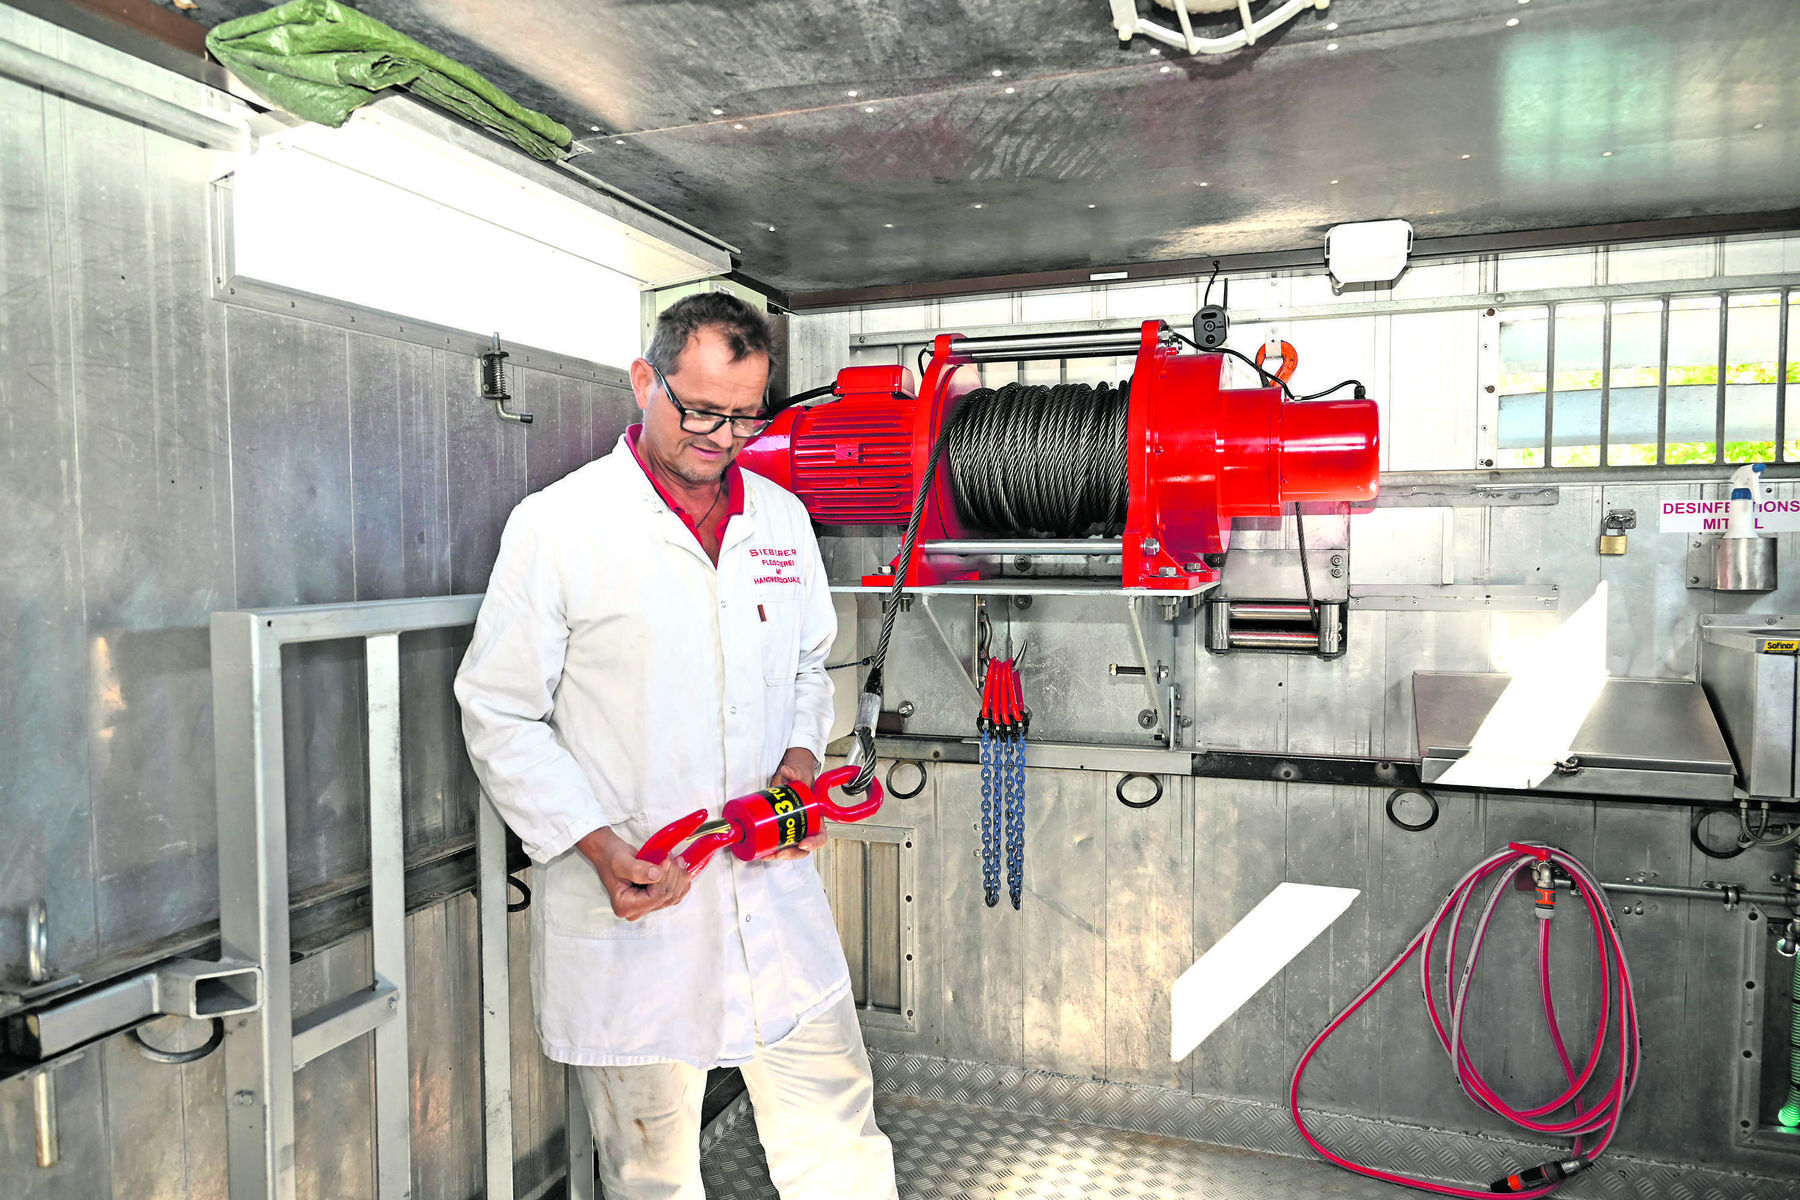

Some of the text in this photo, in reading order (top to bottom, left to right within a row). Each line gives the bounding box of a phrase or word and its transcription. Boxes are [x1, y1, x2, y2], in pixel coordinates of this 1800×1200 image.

[1663, 501, 1800, 514] DESINFEIONS
[1703, 518, 1764, 530] MITL
[774, 800, 794, 815] 3
